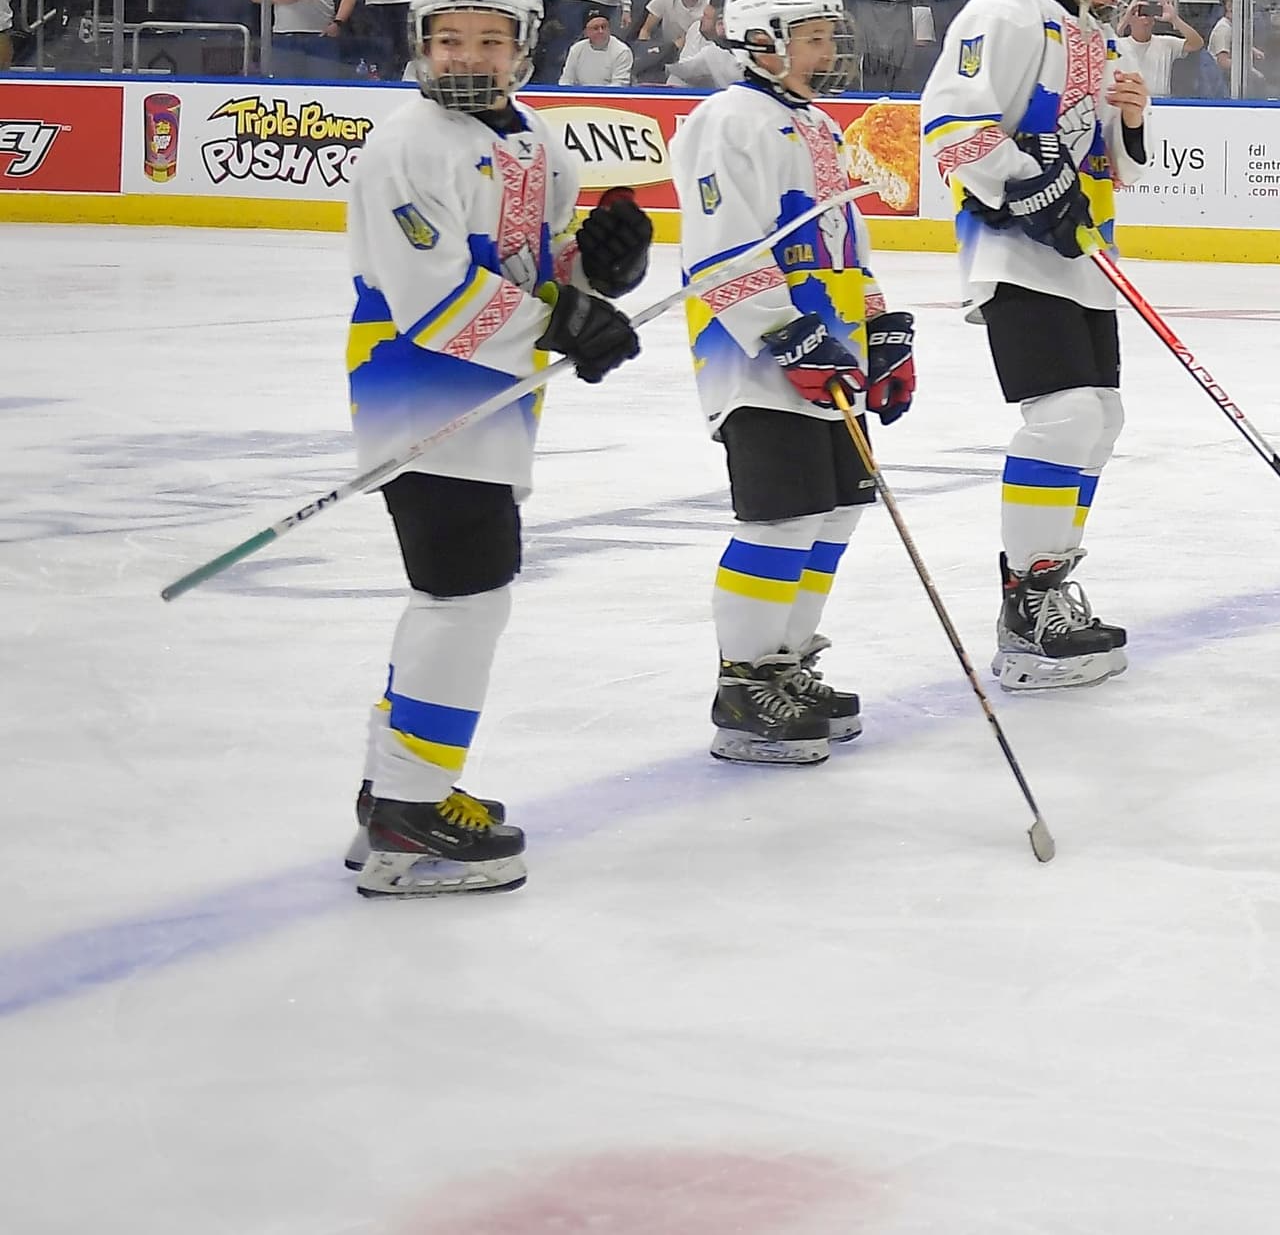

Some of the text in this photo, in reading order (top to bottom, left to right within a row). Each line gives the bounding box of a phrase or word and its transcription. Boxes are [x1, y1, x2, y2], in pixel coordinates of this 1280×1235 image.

[206, 96, 374, 140] Triple Power
[201, 138, 313, 185] PUSH
[1163, 140, 1205, 177] lys
